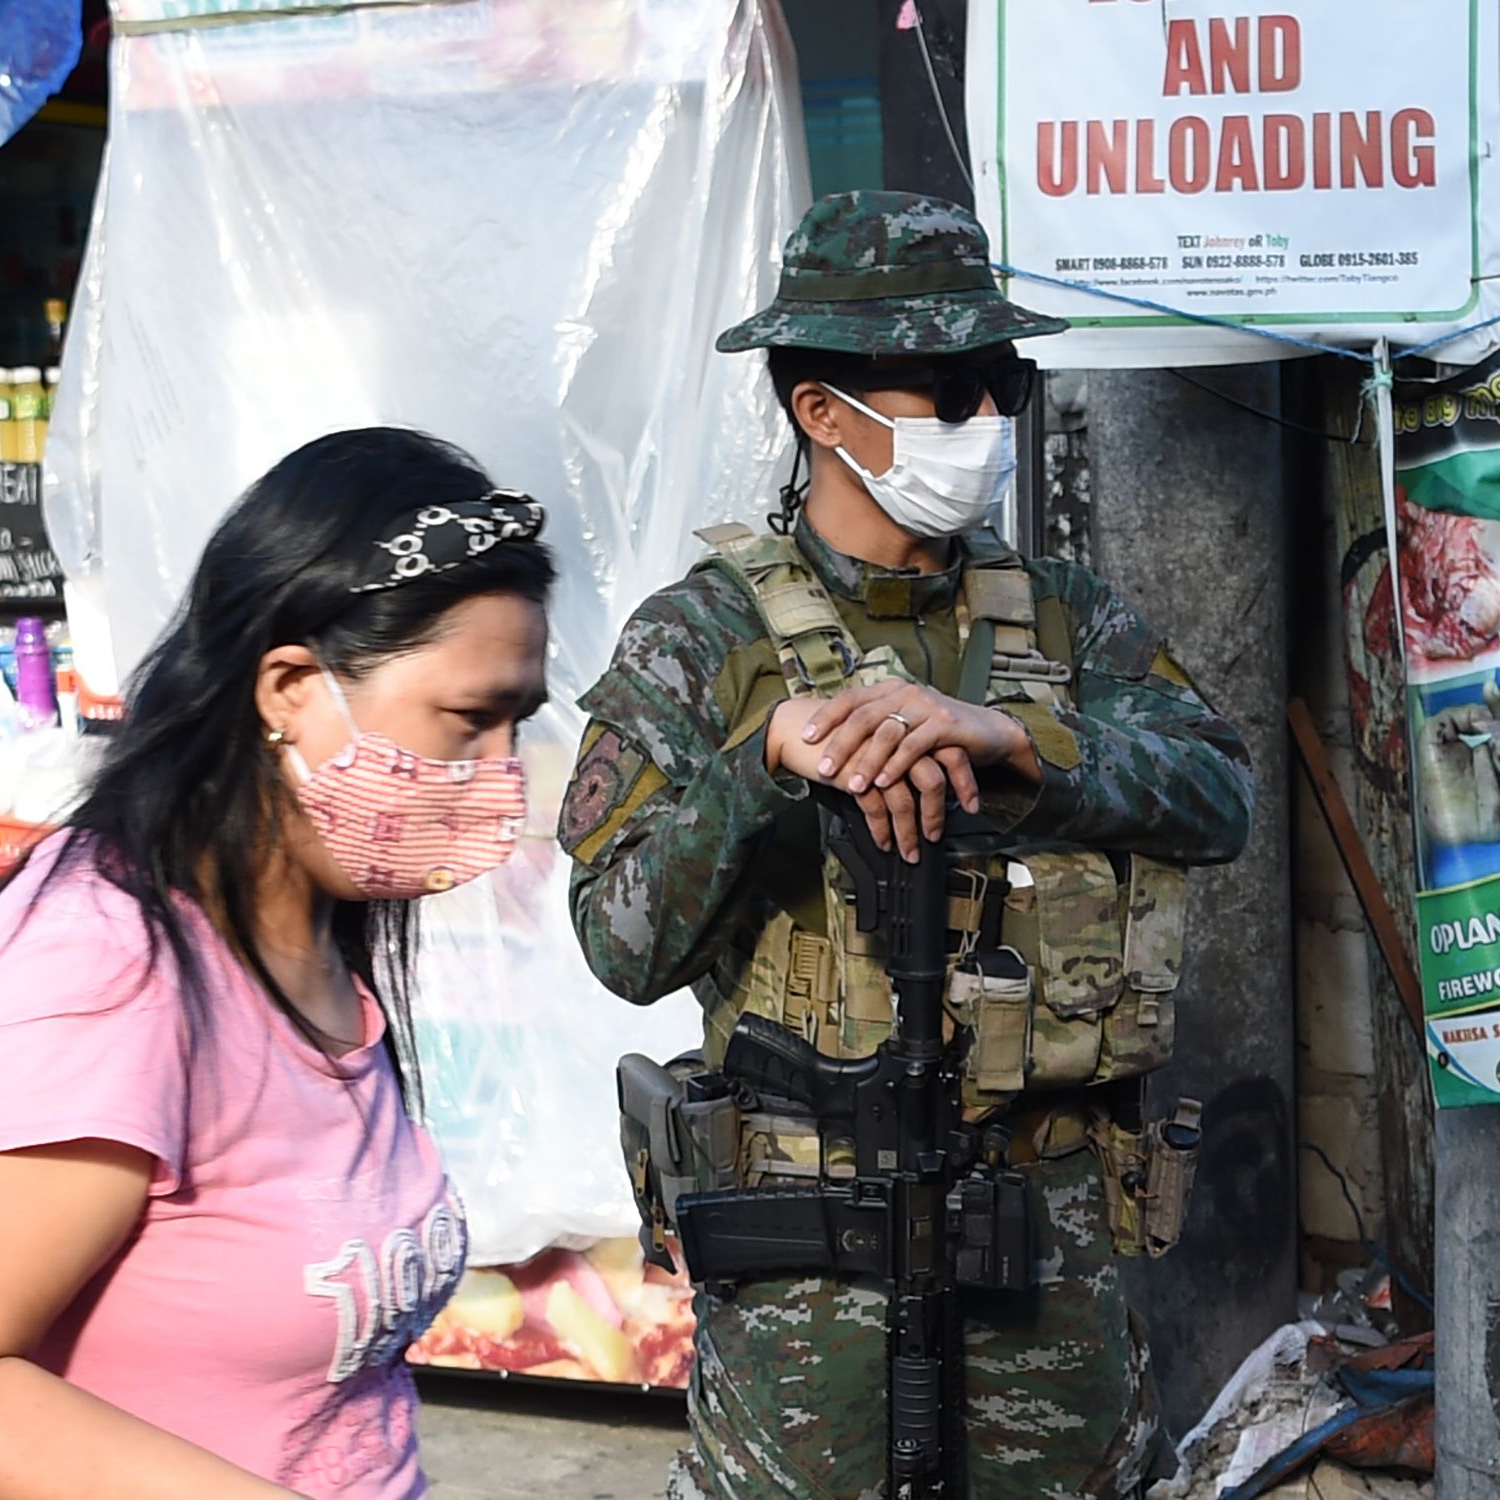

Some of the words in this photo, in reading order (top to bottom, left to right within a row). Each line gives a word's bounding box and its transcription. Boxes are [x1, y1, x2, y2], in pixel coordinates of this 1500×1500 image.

[1162, 14, 1302, 96] AND
[1036, 107, 1437, 197] UNLOADING
[1055, 257, 1090, 272] SMART
[1182, 255, 1203, 269] SUN
[1299, 253, 1334, 268] GLOBE
[1177, 235, 1201, 248] TEXT
[1266, 233, 1290, 250] Toby
